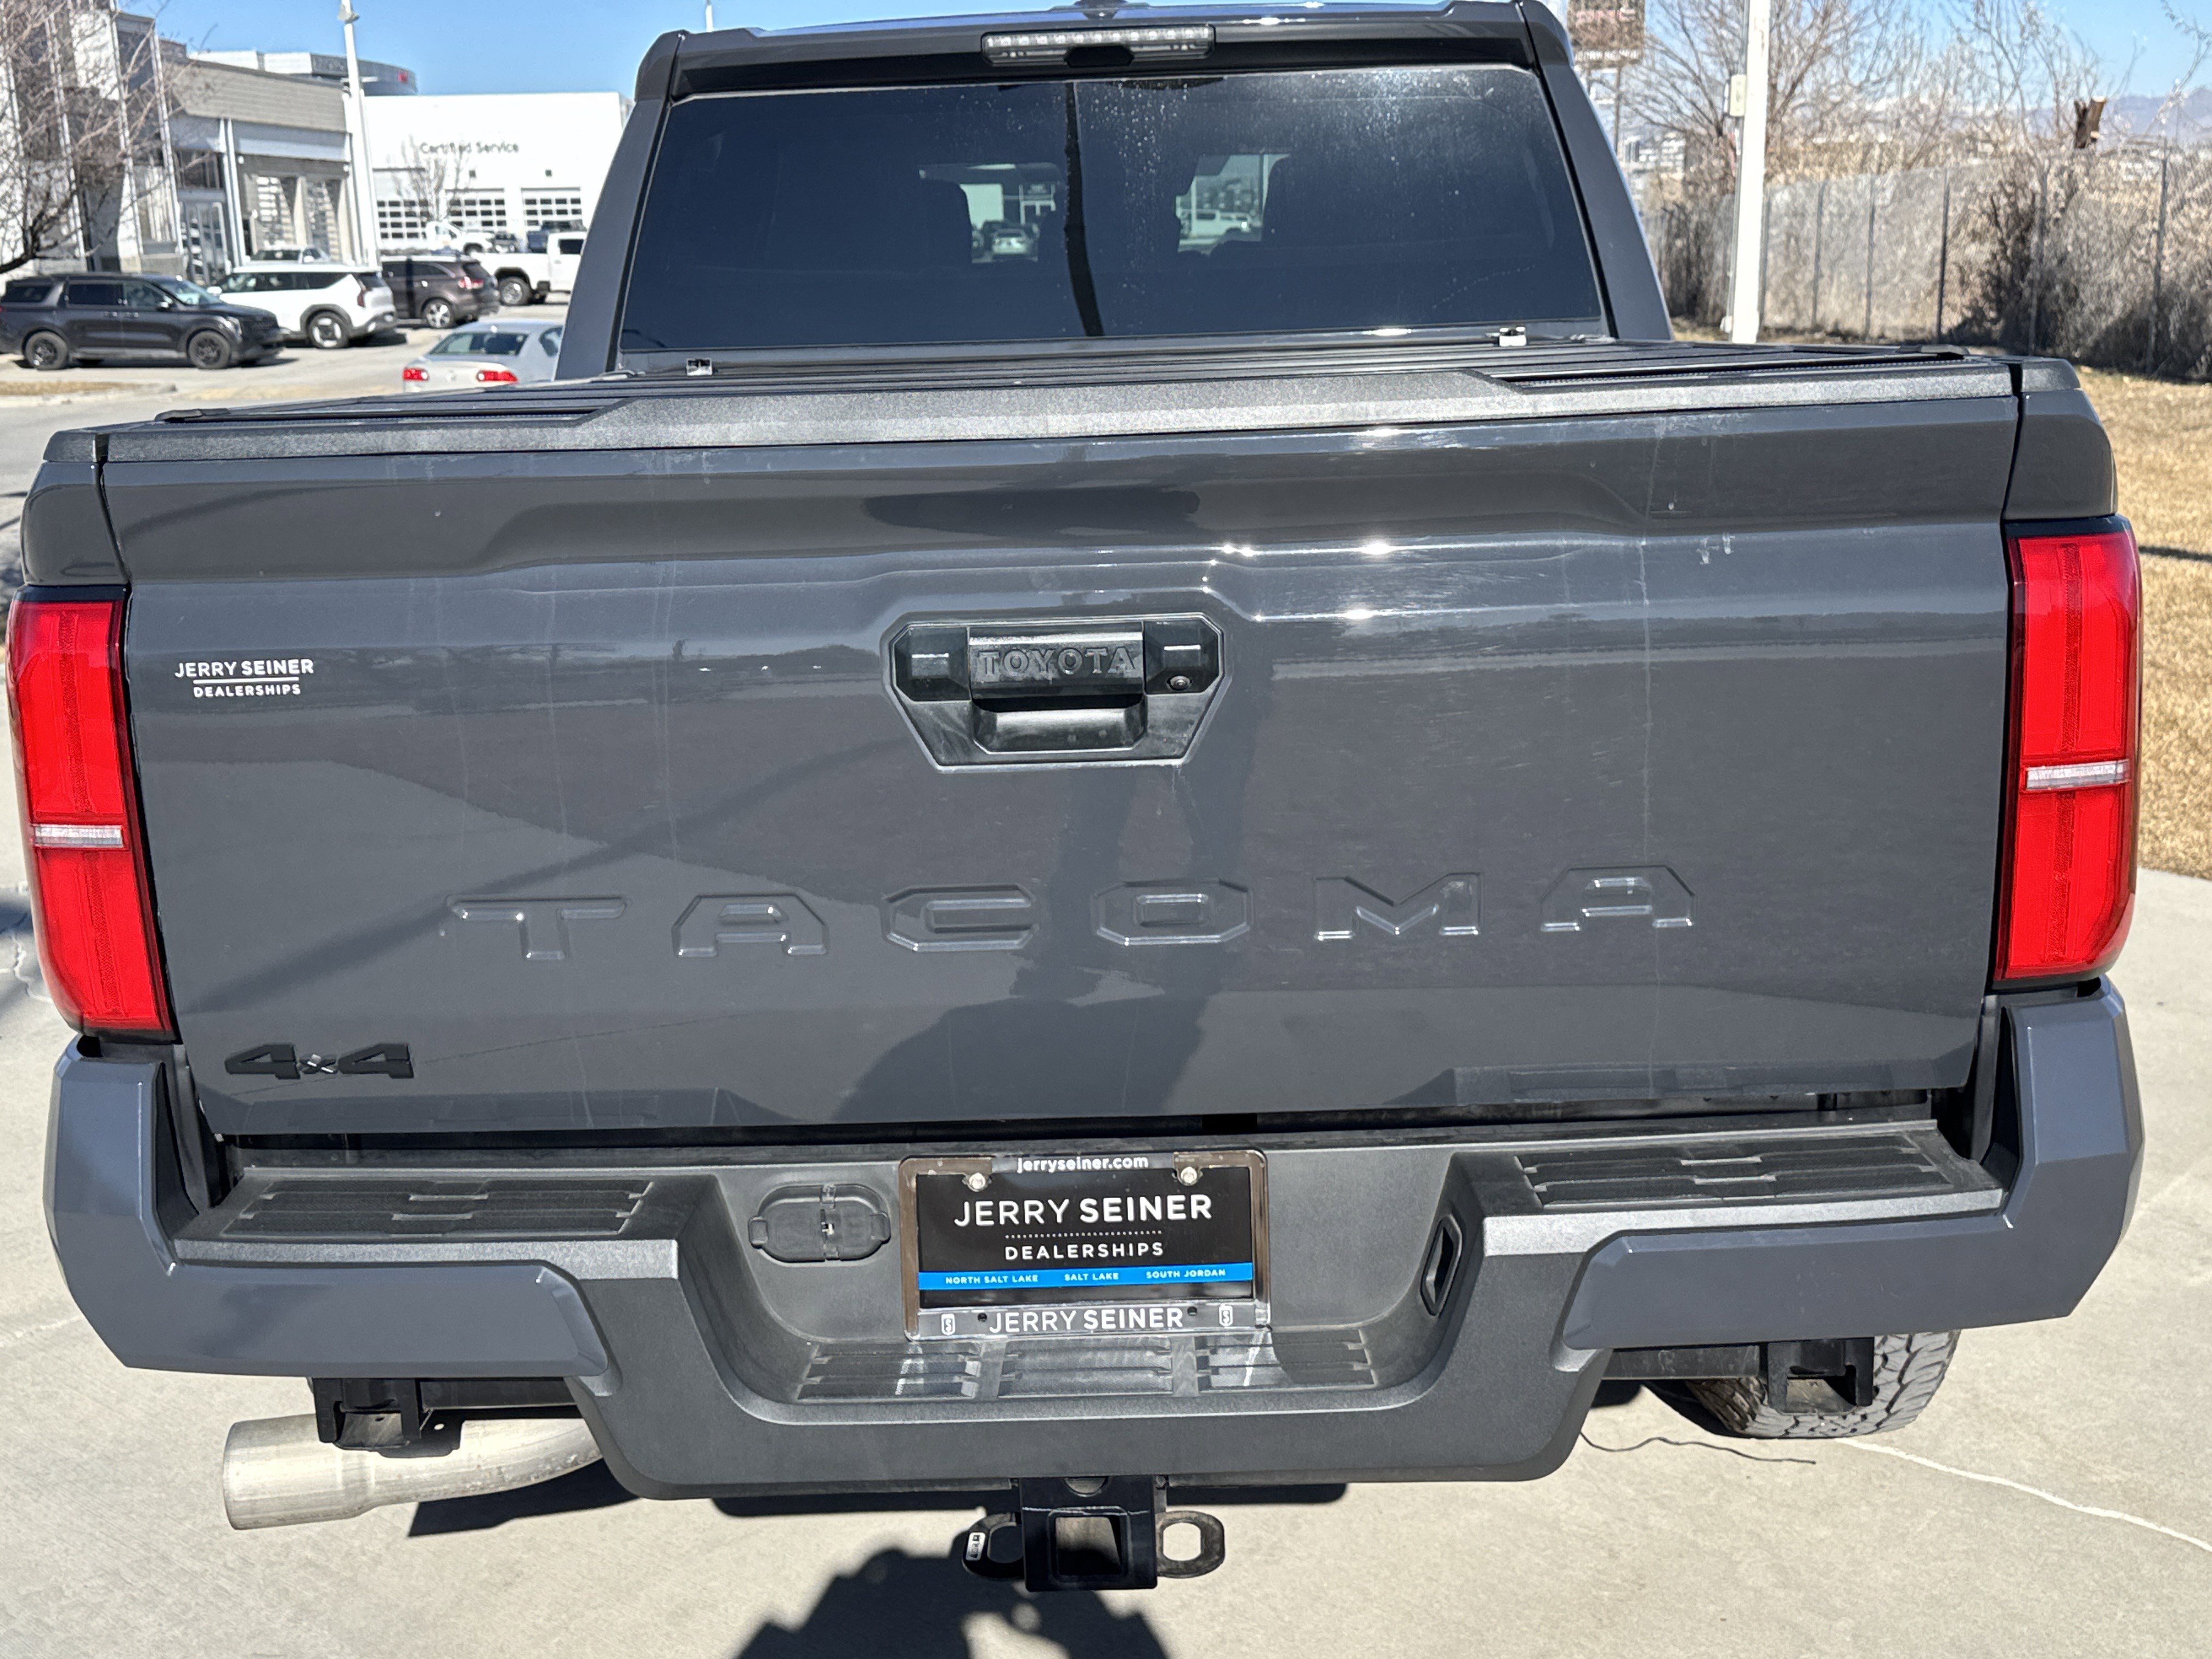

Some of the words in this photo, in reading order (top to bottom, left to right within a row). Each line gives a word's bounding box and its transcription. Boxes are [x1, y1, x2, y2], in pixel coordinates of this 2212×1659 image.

[476, 140, 519, 154] Service
[174, 661, 237, 678] JERRY
[241, 659, 314, 675] SEINER
[978, 647, 1136, 676] TOYOTA
[193, 684, 301, 698] DEALERSHIPS
[445, 864, 1695, 961] TACOMA
[1017, 1156, 1149, 1173] jerryseiner.com
[953, 1199, 1070, 1227] JERRY
[1079, 1194, 1212, 1223] SEINER
[1005, 1242, 1164, 1260] DEALERSHIPS
[945, 1276, 981, 1284] NORTH
[984, 1276, 1009, 1284] SALT
[1012, 1274, 1039, 1283] LAKE
[1092, 1272, 1119, 1280] LAKE
[1146, 1271, 1181, 1279] SOUTH
[1184, 1269, 1226, 1278] JORDAN
[989, 1310, 1076, 1333] JERRY
[1083, 1307, 1183, 1331] SEINER
